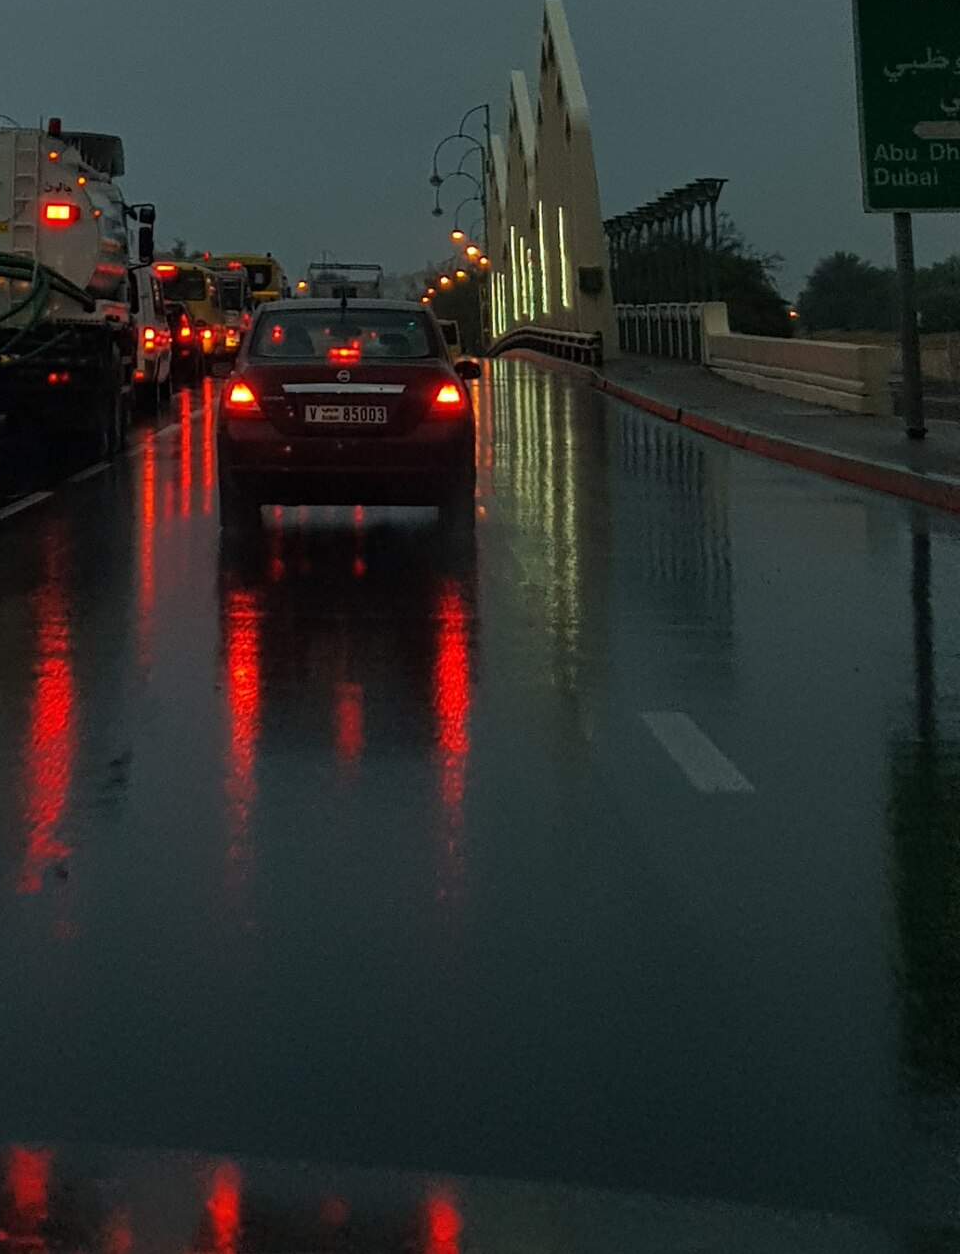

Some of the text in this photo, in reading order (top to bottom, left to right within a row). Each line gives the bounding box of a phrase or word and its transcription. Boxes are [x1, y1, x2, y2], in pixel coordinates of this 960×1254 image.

[873, 143, 918, 162] Abu
[873, 166, 939, 187] Dubai
[310, 407, 385, 422] V 85003
